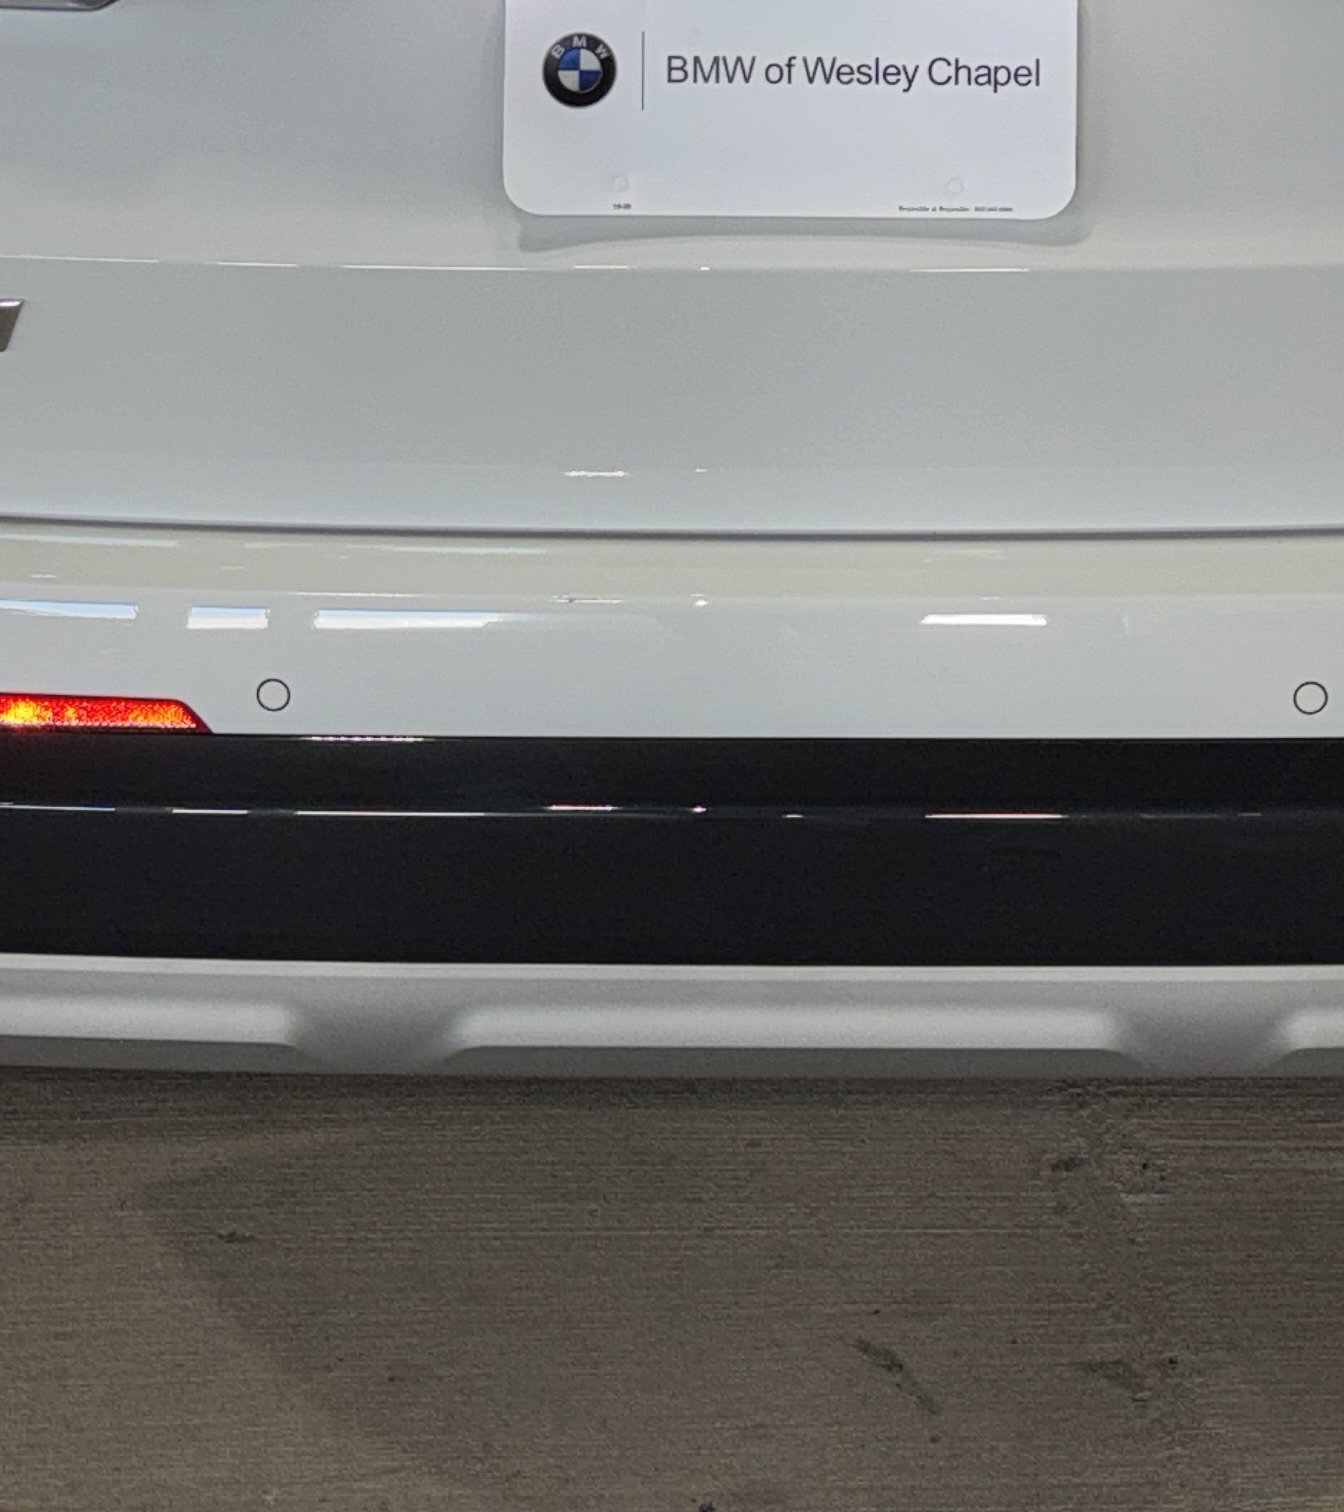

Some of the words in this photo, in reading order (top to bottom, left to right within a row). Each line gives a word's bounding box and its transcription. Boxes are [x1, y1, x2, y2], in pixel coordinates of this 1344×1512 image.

[551, 36, 609, 59] BMW
[666, 55, 756, 84] BMW
[764, 56, 797, 84] of
[802, 56, 919, 92] Wesley
[927, 57, 1041, 94] Chapel
